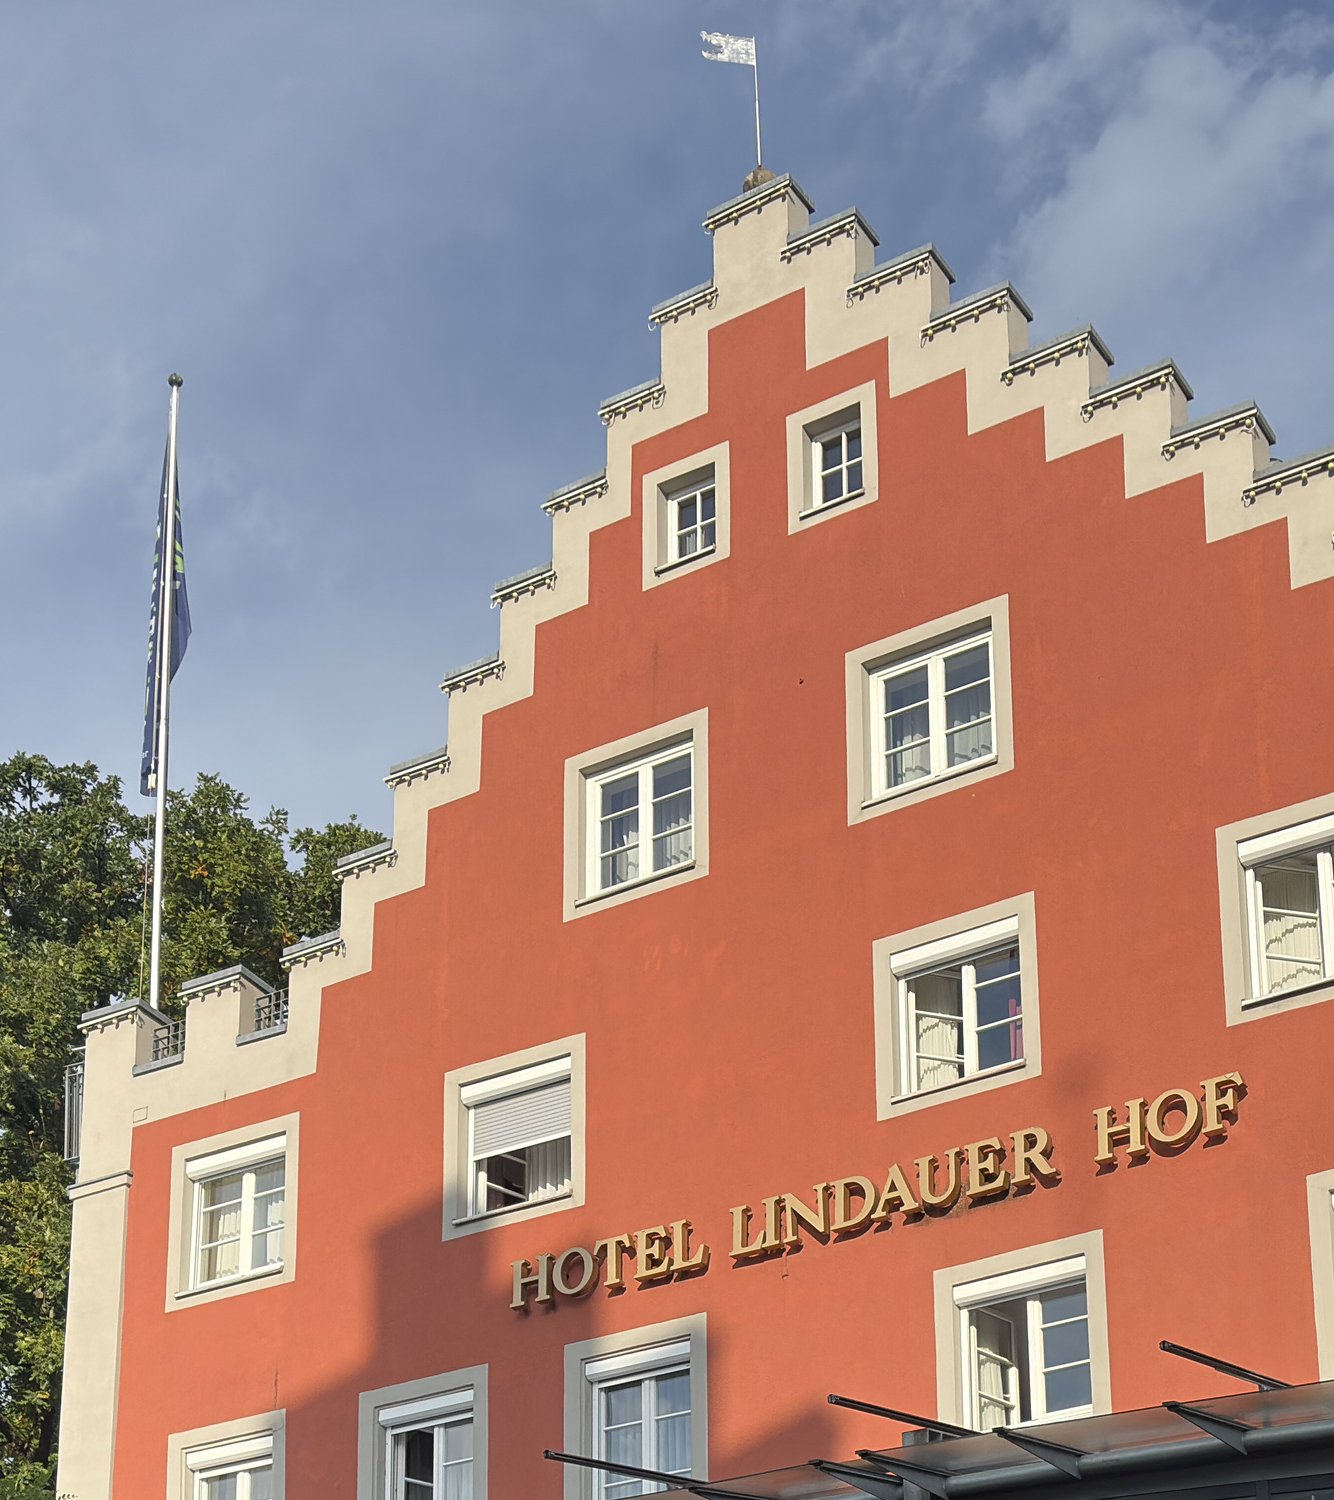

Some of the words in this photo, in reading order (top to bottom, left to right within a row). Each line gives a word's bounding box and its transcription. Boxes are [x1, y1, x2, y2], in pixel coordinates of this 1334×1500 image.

[509, 1218, 710, 1311] HOTEL
[728, 1126, 1062, 1259] LINDAUER
[1092, 1070, 1246, 1166] HOF
